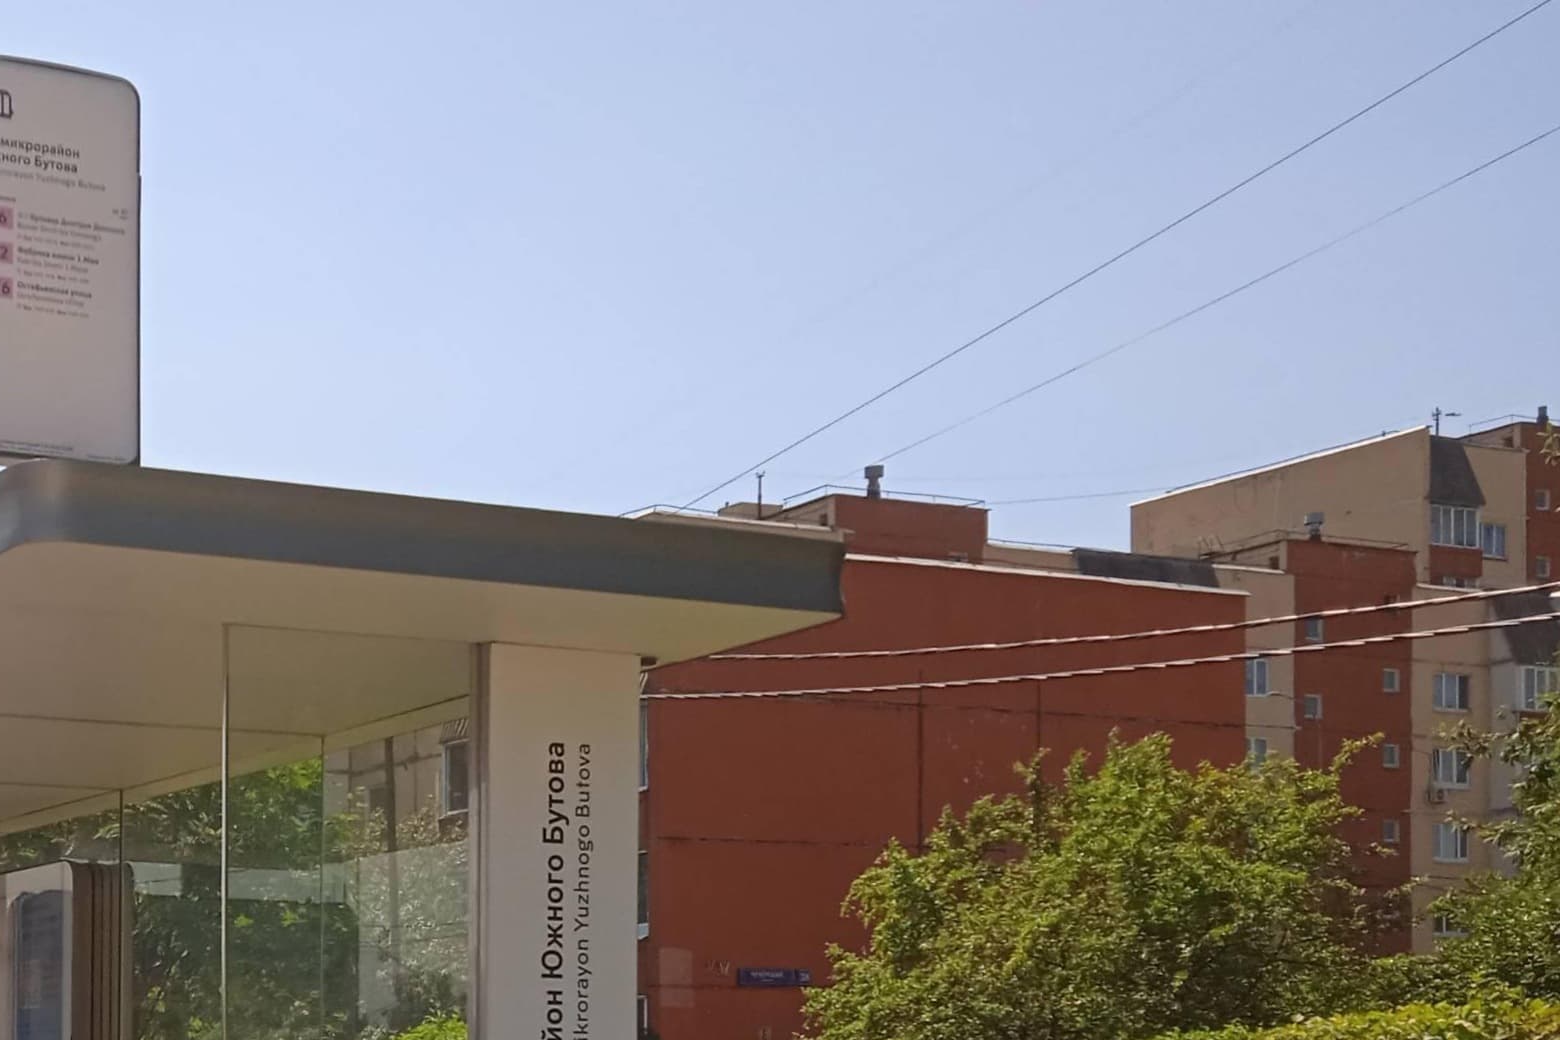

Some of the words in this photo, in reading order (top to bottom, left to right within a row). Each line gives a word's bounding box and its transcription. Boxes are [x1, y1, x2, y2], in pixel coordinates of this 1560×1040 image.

[0, 137, 80, 159] микрорайон
[34, 156, 78, 174] Бутова
[542, 742, 569, 844] Бутова
[575, 743, 591, 817] Butova
[541, 854, 565, 979] Южного
[573, 824, 594, 932] Yuzhnogo
